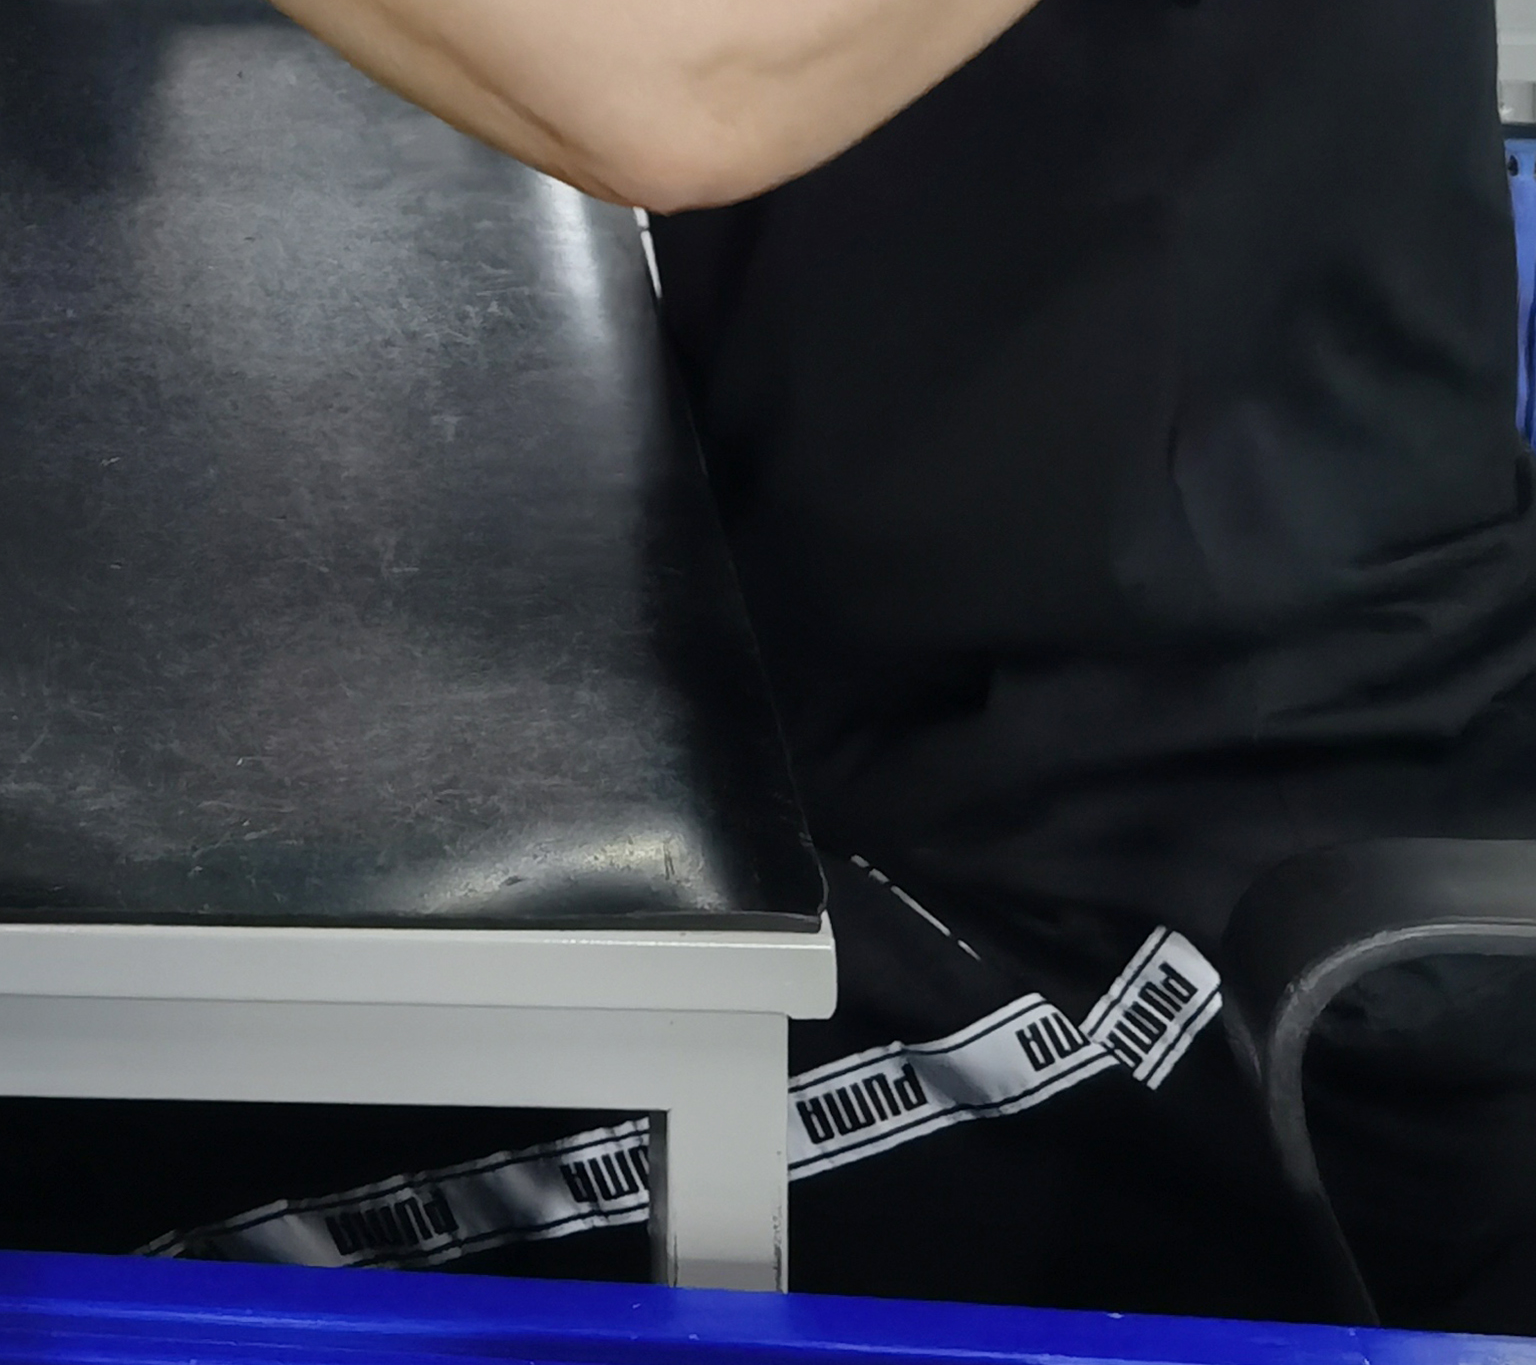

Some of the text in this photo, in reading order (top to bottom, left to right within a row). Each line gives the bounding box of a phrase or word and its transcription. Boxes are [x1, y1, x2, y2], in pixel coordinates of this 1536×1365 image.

[1015, 1012, 1090, 1072] MA
[1106, 961, 1198, 1069] PUMA
[796, 1063, 927, 1145] PUMA
[561, 1146, 649, 1203] UMA
[325, 1189, 459, 1256] PUMA
